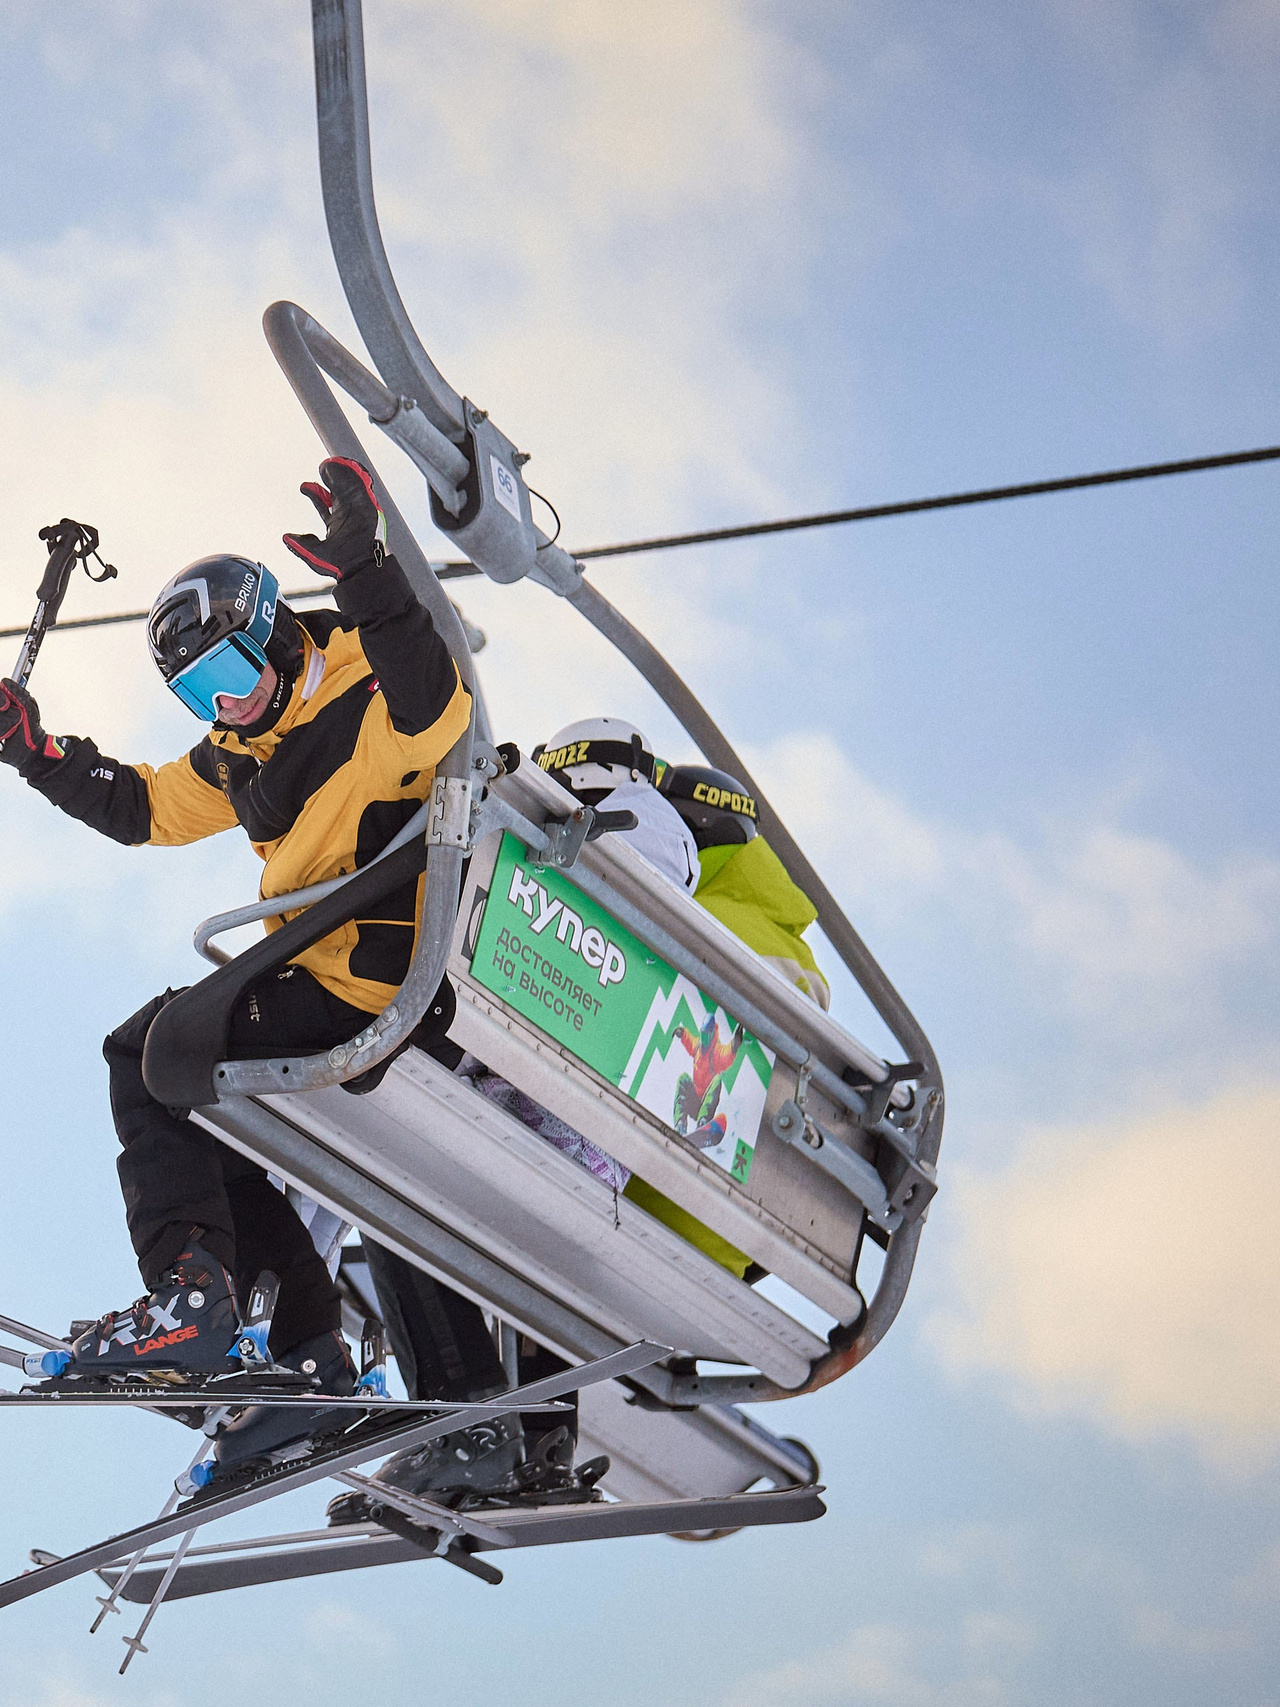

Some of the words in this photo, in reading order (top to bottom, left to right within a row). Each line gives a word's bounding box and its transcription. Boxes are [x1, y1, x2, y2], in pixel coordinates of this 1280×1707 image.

[498, 467, 512, 493] 66
[234, 572, 256, 613] BRIKO
[692, 782, 757, 819] COPOZZ
[492, 950, 516, 980] на
[519, 970, 584, 1032] высоте
[496, 927, 603, 1017] доставляет
[133, 1324, 200, 1356] LANGE
